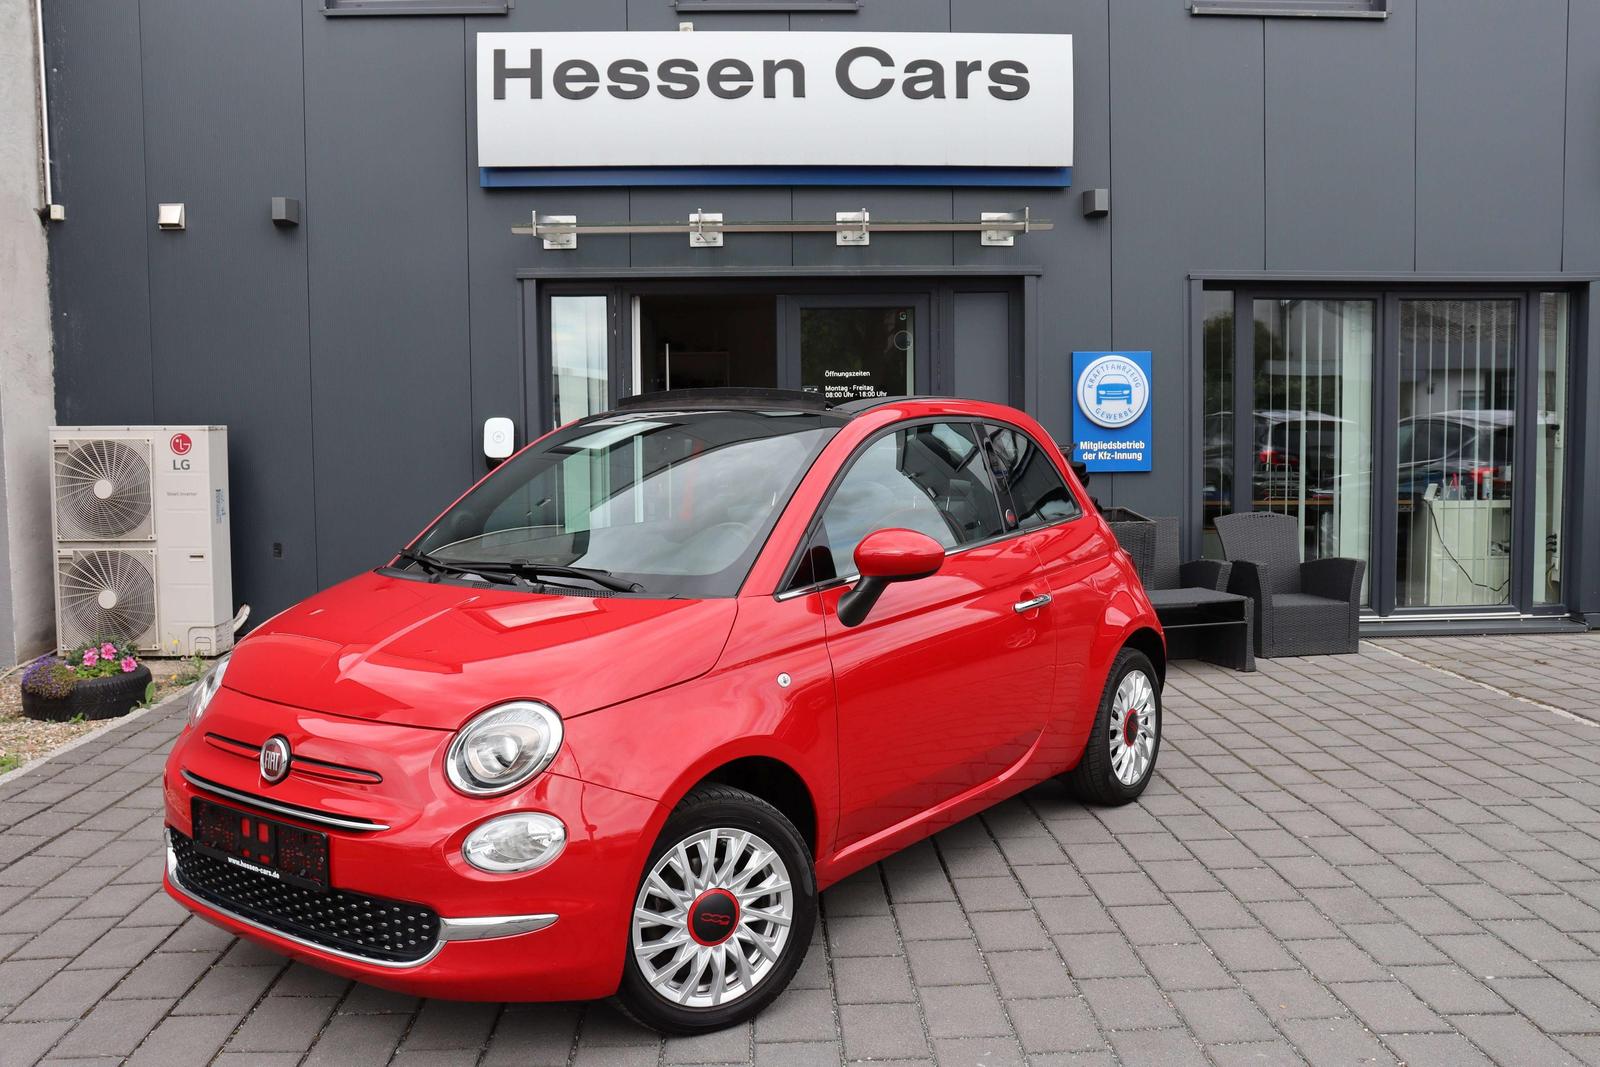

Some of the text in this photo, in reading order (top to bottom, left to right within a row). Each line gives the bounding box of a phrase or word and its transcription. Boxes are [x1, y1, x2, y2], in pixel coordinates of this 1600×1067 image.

[493, 46, 1031, 100] Hessen Cars
[824, 370, 871, 378] Öffnungszeiten
[1087, 363, 1142, 389] KRAFTFAHRZEUG
[853, 384, 874, 392] Freitag
[1095, 407, 1133, 420] GEWERBE
[1080, 440, 1145, 452] Mitgliedsbetrieb
[1082, 451, 1143, 462] der Kfz-Innung
[172, 459, 191, 471] LG
[264, 750, 281, 772] FIAT
